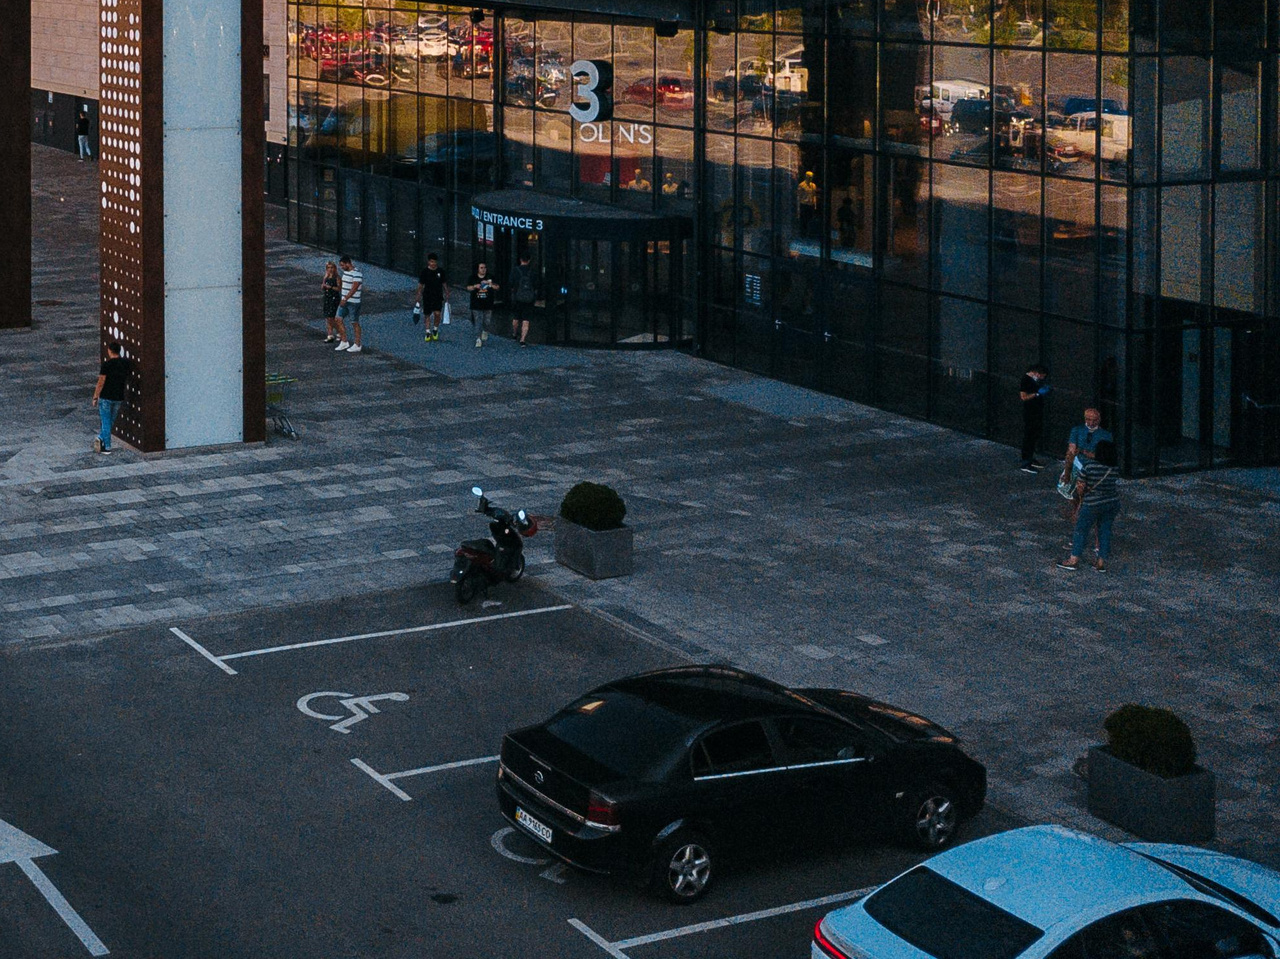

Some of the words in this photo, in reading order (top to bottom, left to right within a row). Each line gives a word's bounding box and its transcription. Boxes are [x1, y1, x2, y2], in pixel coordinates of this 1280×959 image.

[569, 60, 602, 123] 3
[580, 123, 652, 144] OLN'S
[483, 211, 532, 230] ENTRANCE
[535, 220, 543, 230] 3
